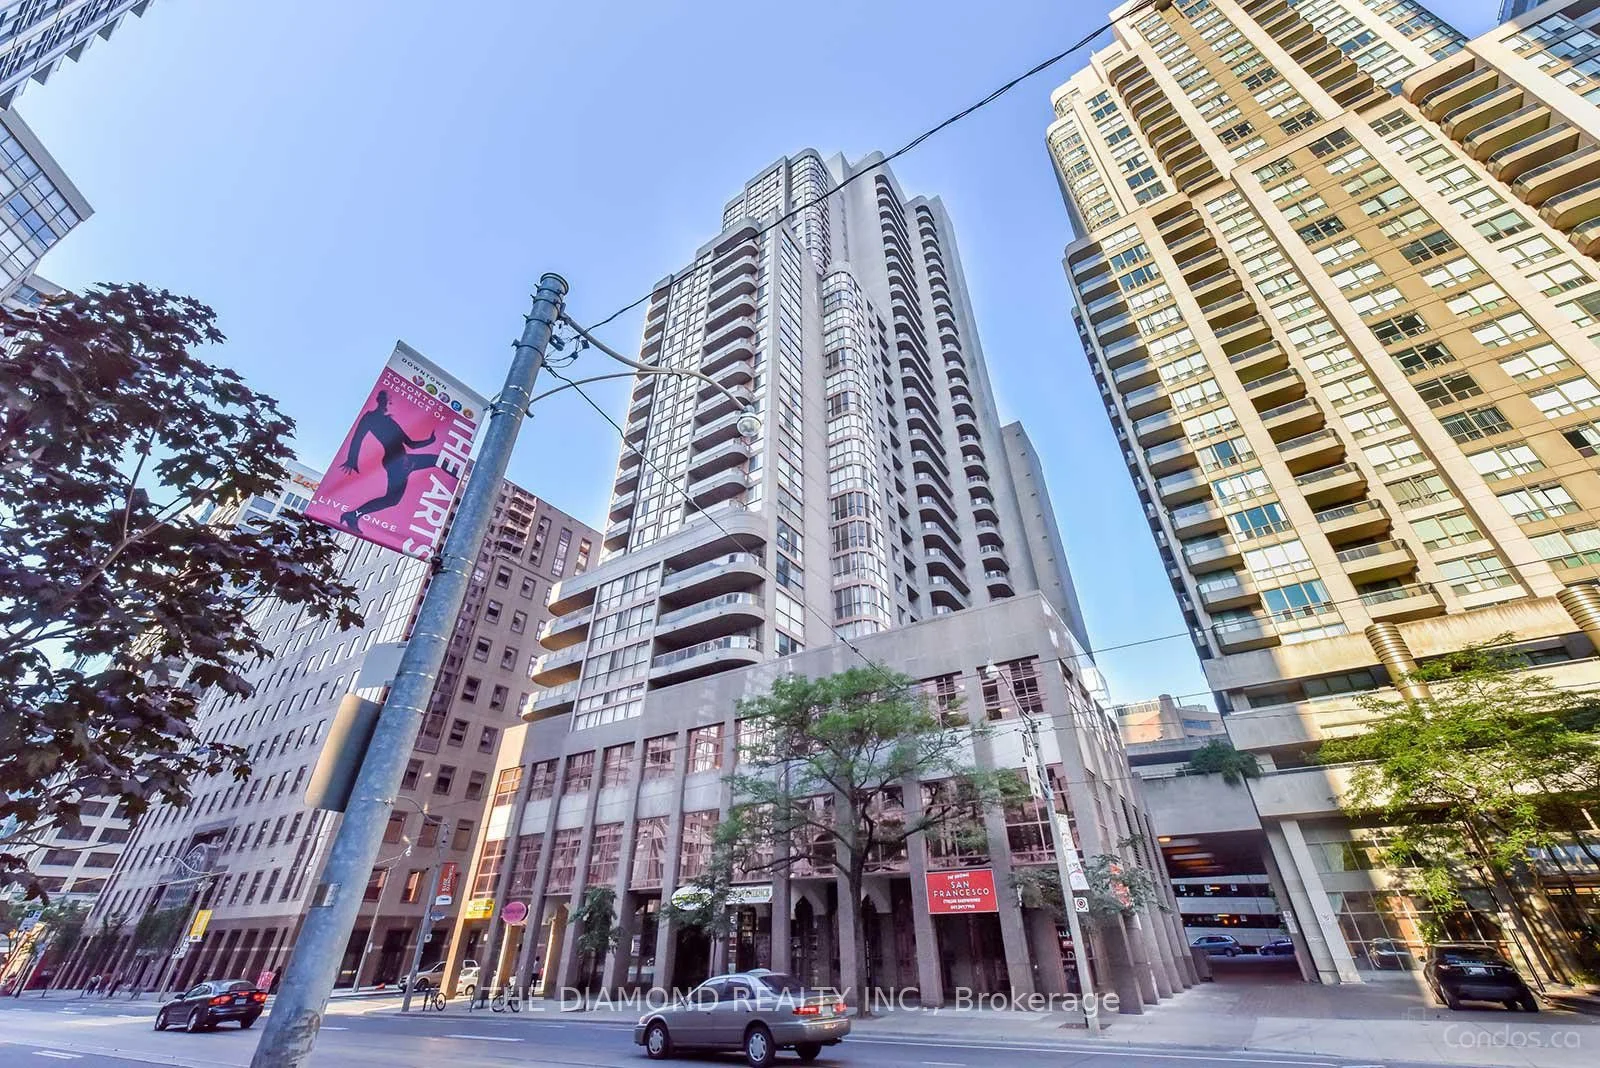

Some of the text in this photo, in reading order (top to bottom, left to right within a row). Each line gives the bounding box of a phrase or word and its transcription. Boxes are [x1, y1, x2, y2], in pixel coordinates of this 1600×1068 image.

[387, 372, 444, 412] TORONTO'S
[401, 358, 447, 390] DOWNTOWN
[383, 379, 447, 421] DISTRICT OF
[402, 418, 477, 563] THE ARTS
[318, 495, 397, 532] LIVE YONGE
[933, 888, 990, 897] FRANCESCO
[950, 880, 970, 889] SAN
